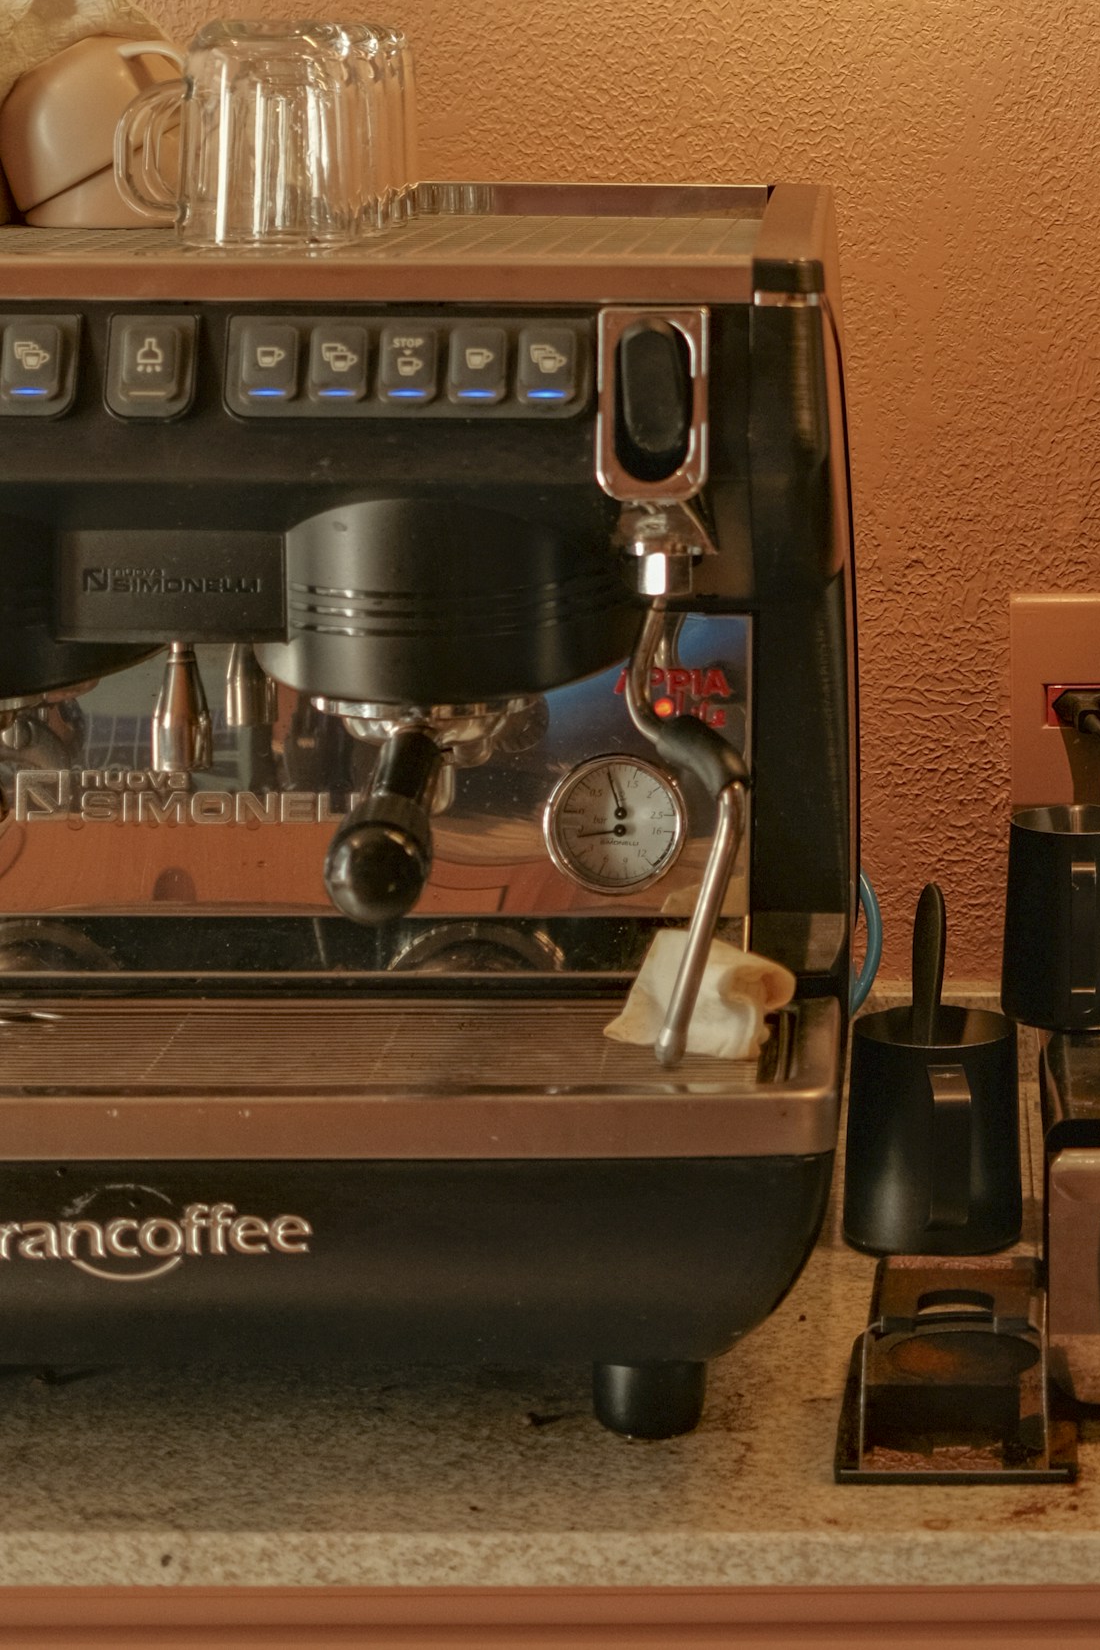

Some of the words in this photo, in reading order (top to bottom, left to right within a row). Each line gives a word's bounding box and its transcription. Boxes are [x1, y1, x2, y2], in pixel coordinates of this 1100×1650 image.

[393, 337, 424, 349] STOP
[113, 578, 261, 593] SIMONELLI
[80, 769, 190, 790] nuova
[80, 791, 357, 824] SIMONEL
